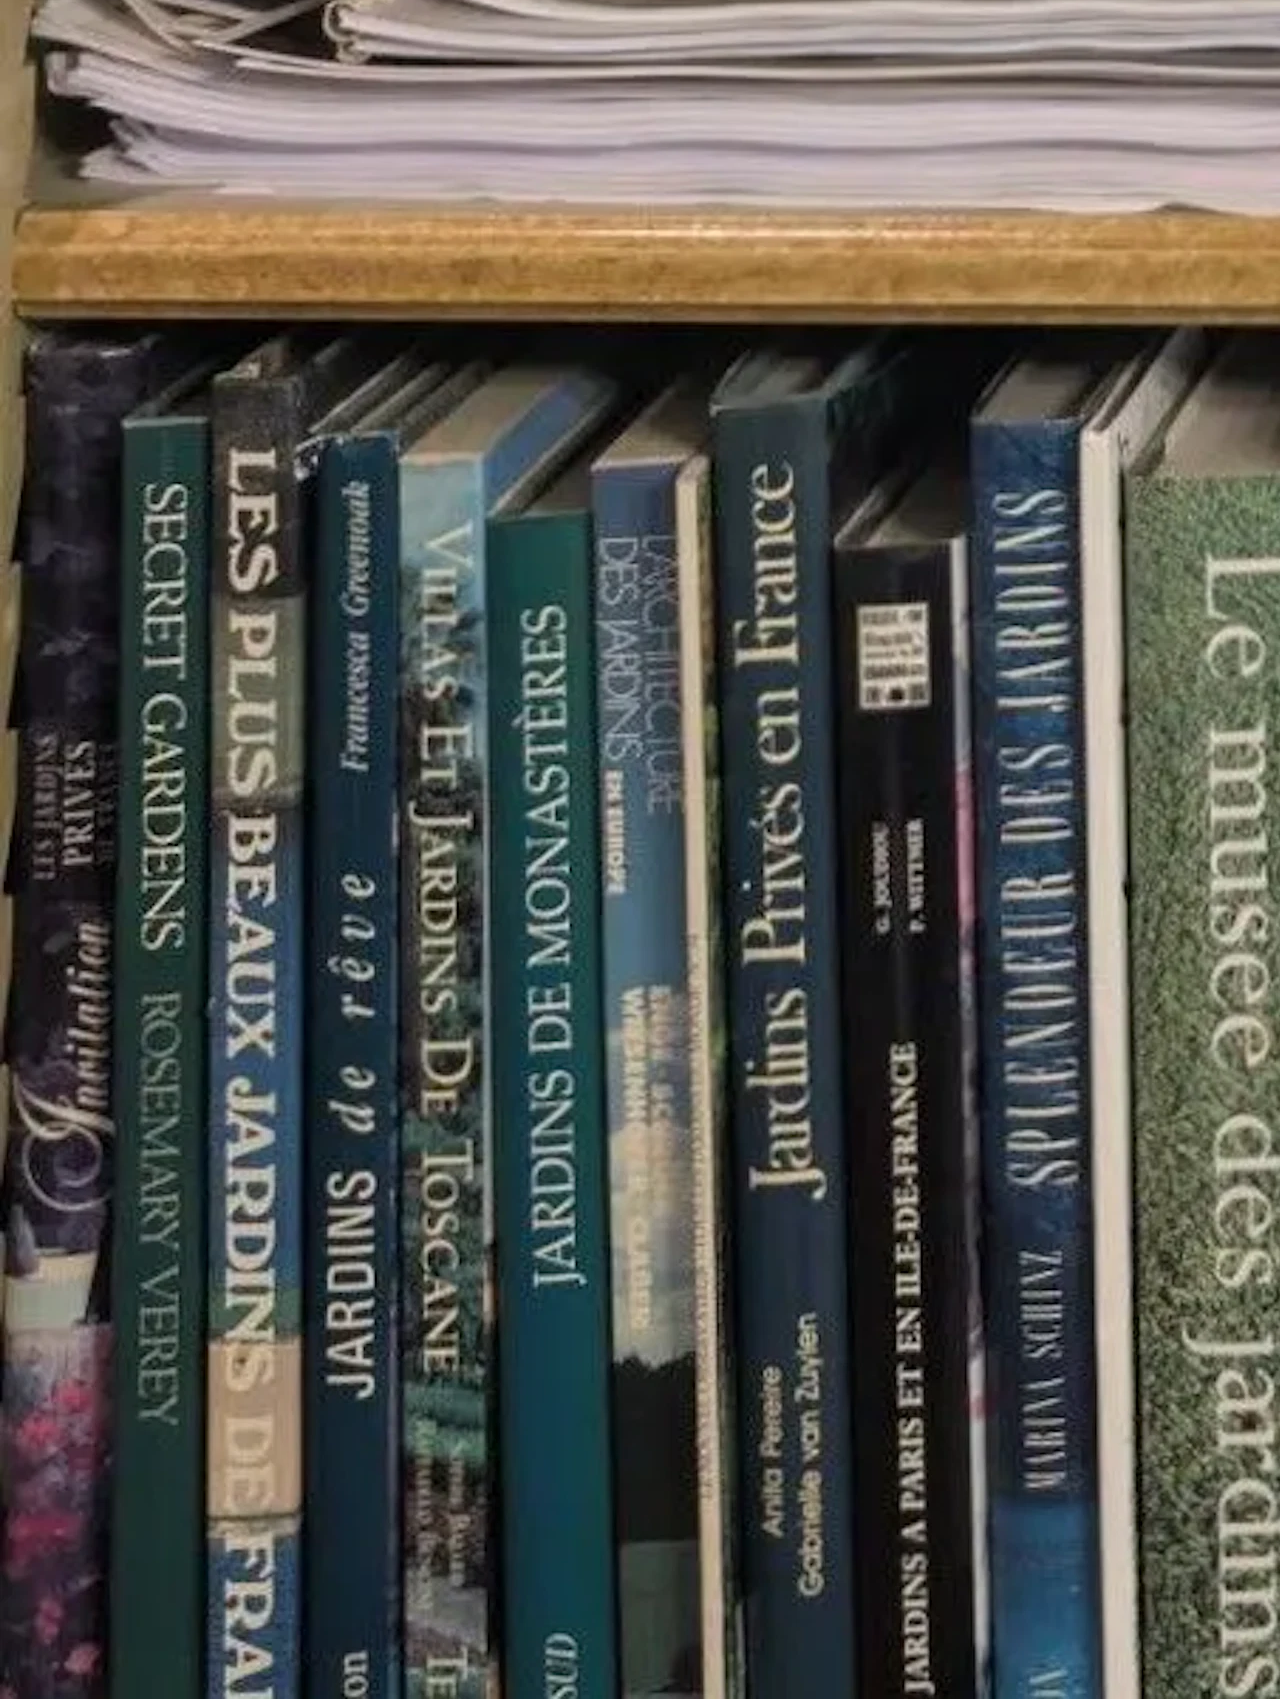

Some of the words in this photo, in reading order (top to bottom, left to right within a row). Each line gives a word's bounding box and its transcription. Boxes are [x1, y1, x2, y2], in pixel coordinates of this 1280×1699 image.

[141, 483, 188, 680] SECRET
[734, 463, 796, 668] France
[756, 689, 799, 763] en
[141, 694, 188, 950] GARDENS
[741, 784, 806, 964] Privés
[140, 993, 188, 1252] ROSEMARY
[745, 990, 828, 1200] Jardins
[890, 1043, 922, 1299] ILE-DE-FRANCE
[139, 1265, 180, 1425] VEREY
[896, 1307, 922, 1351] EN
[897, 1371, 922, 1406] ET
[898, 1417, 924, 1510] PARIS
[900, 1521, 927, 1541] A
[900, 1554, 931, 1693] JARDINS
